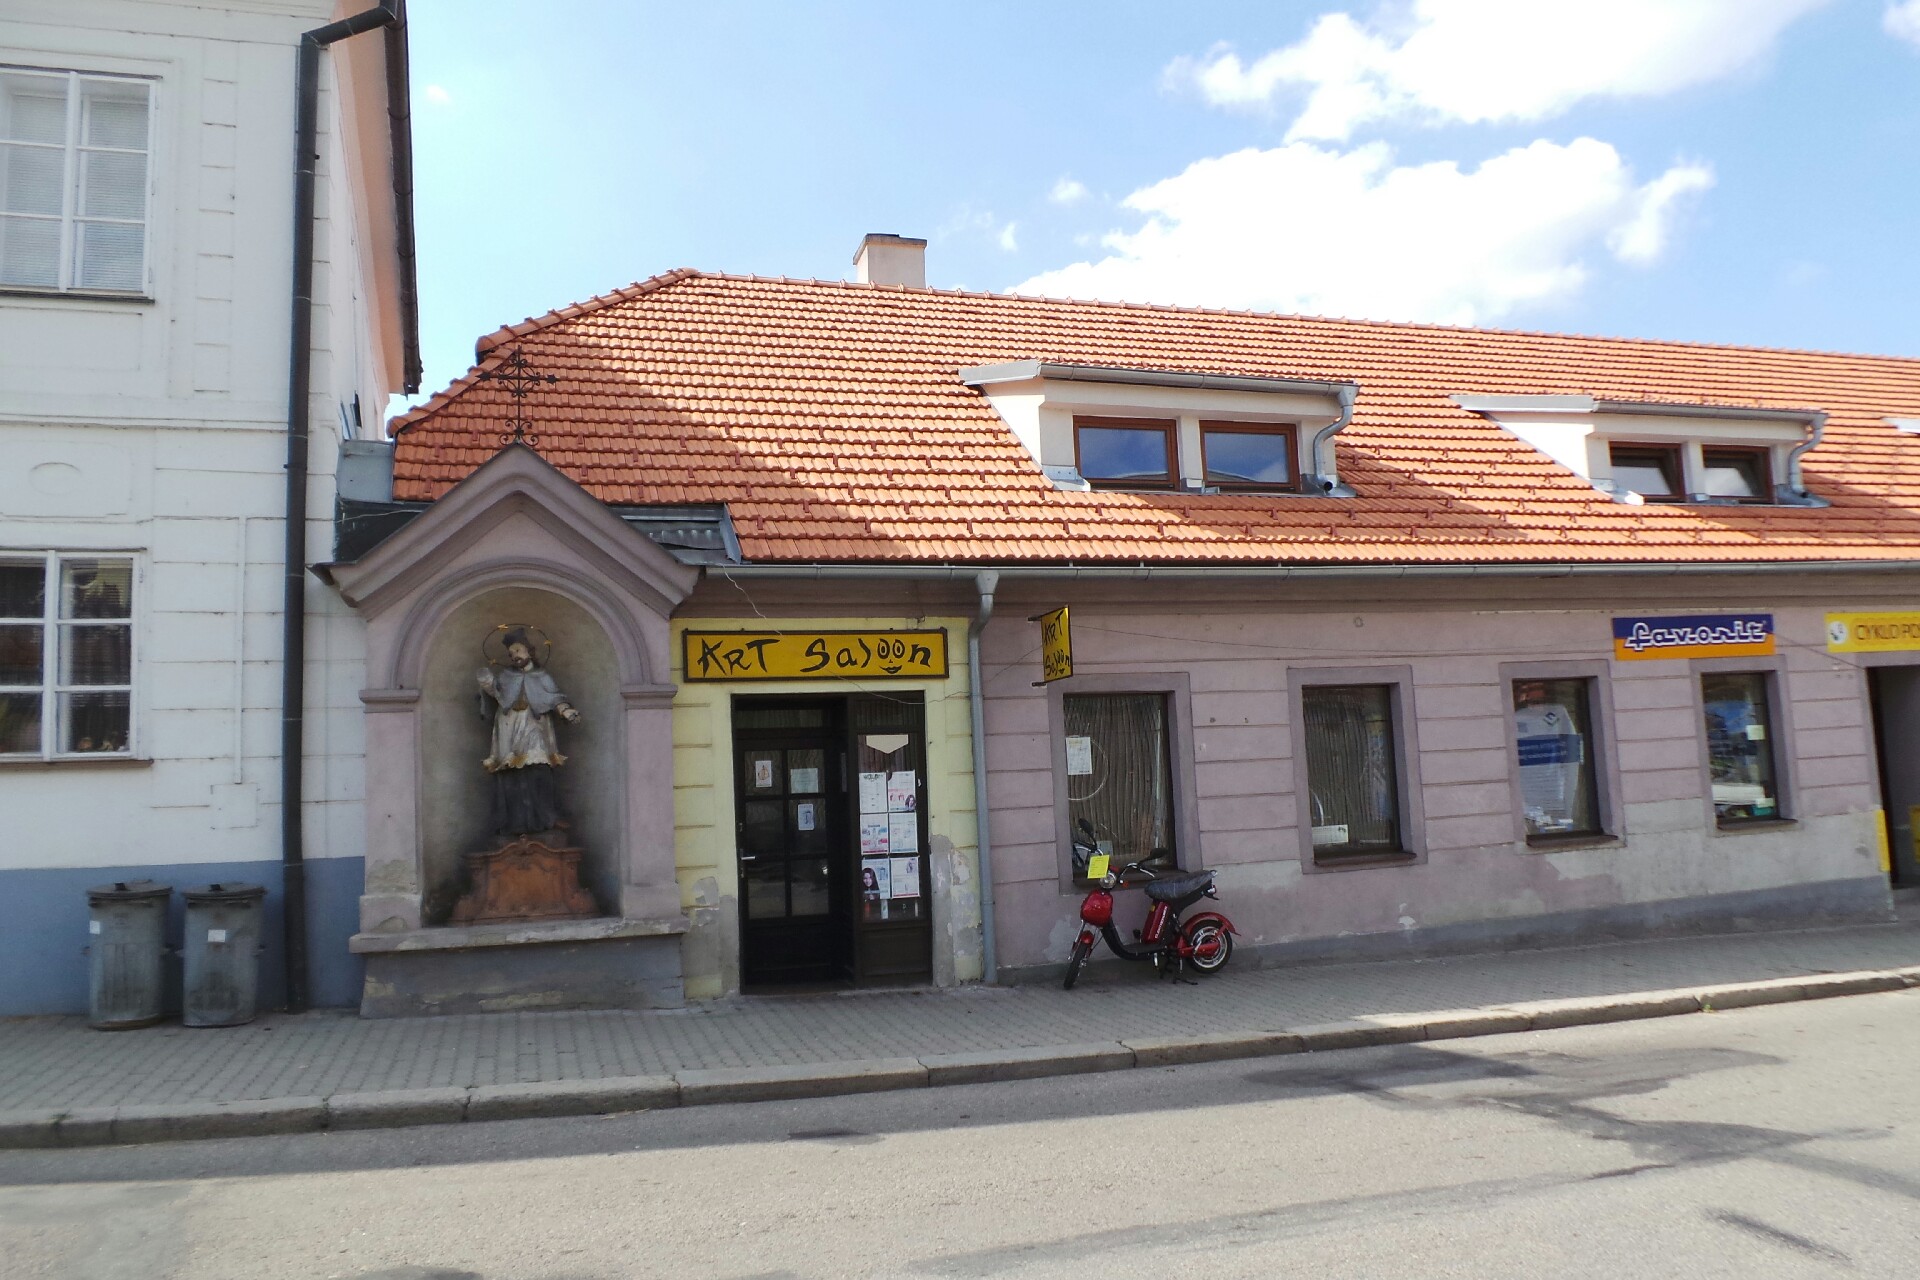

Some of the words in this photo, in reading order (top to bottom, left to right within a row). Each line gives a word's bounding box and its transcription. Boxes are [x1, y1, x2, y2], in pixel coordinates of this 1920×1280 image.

[1044, 609, 1064, 646] ART
[1855, 624, 1898, 641] CYKLO
[697, 638, 780, 677] ART
[799, 637, 932, 674] Saloon
